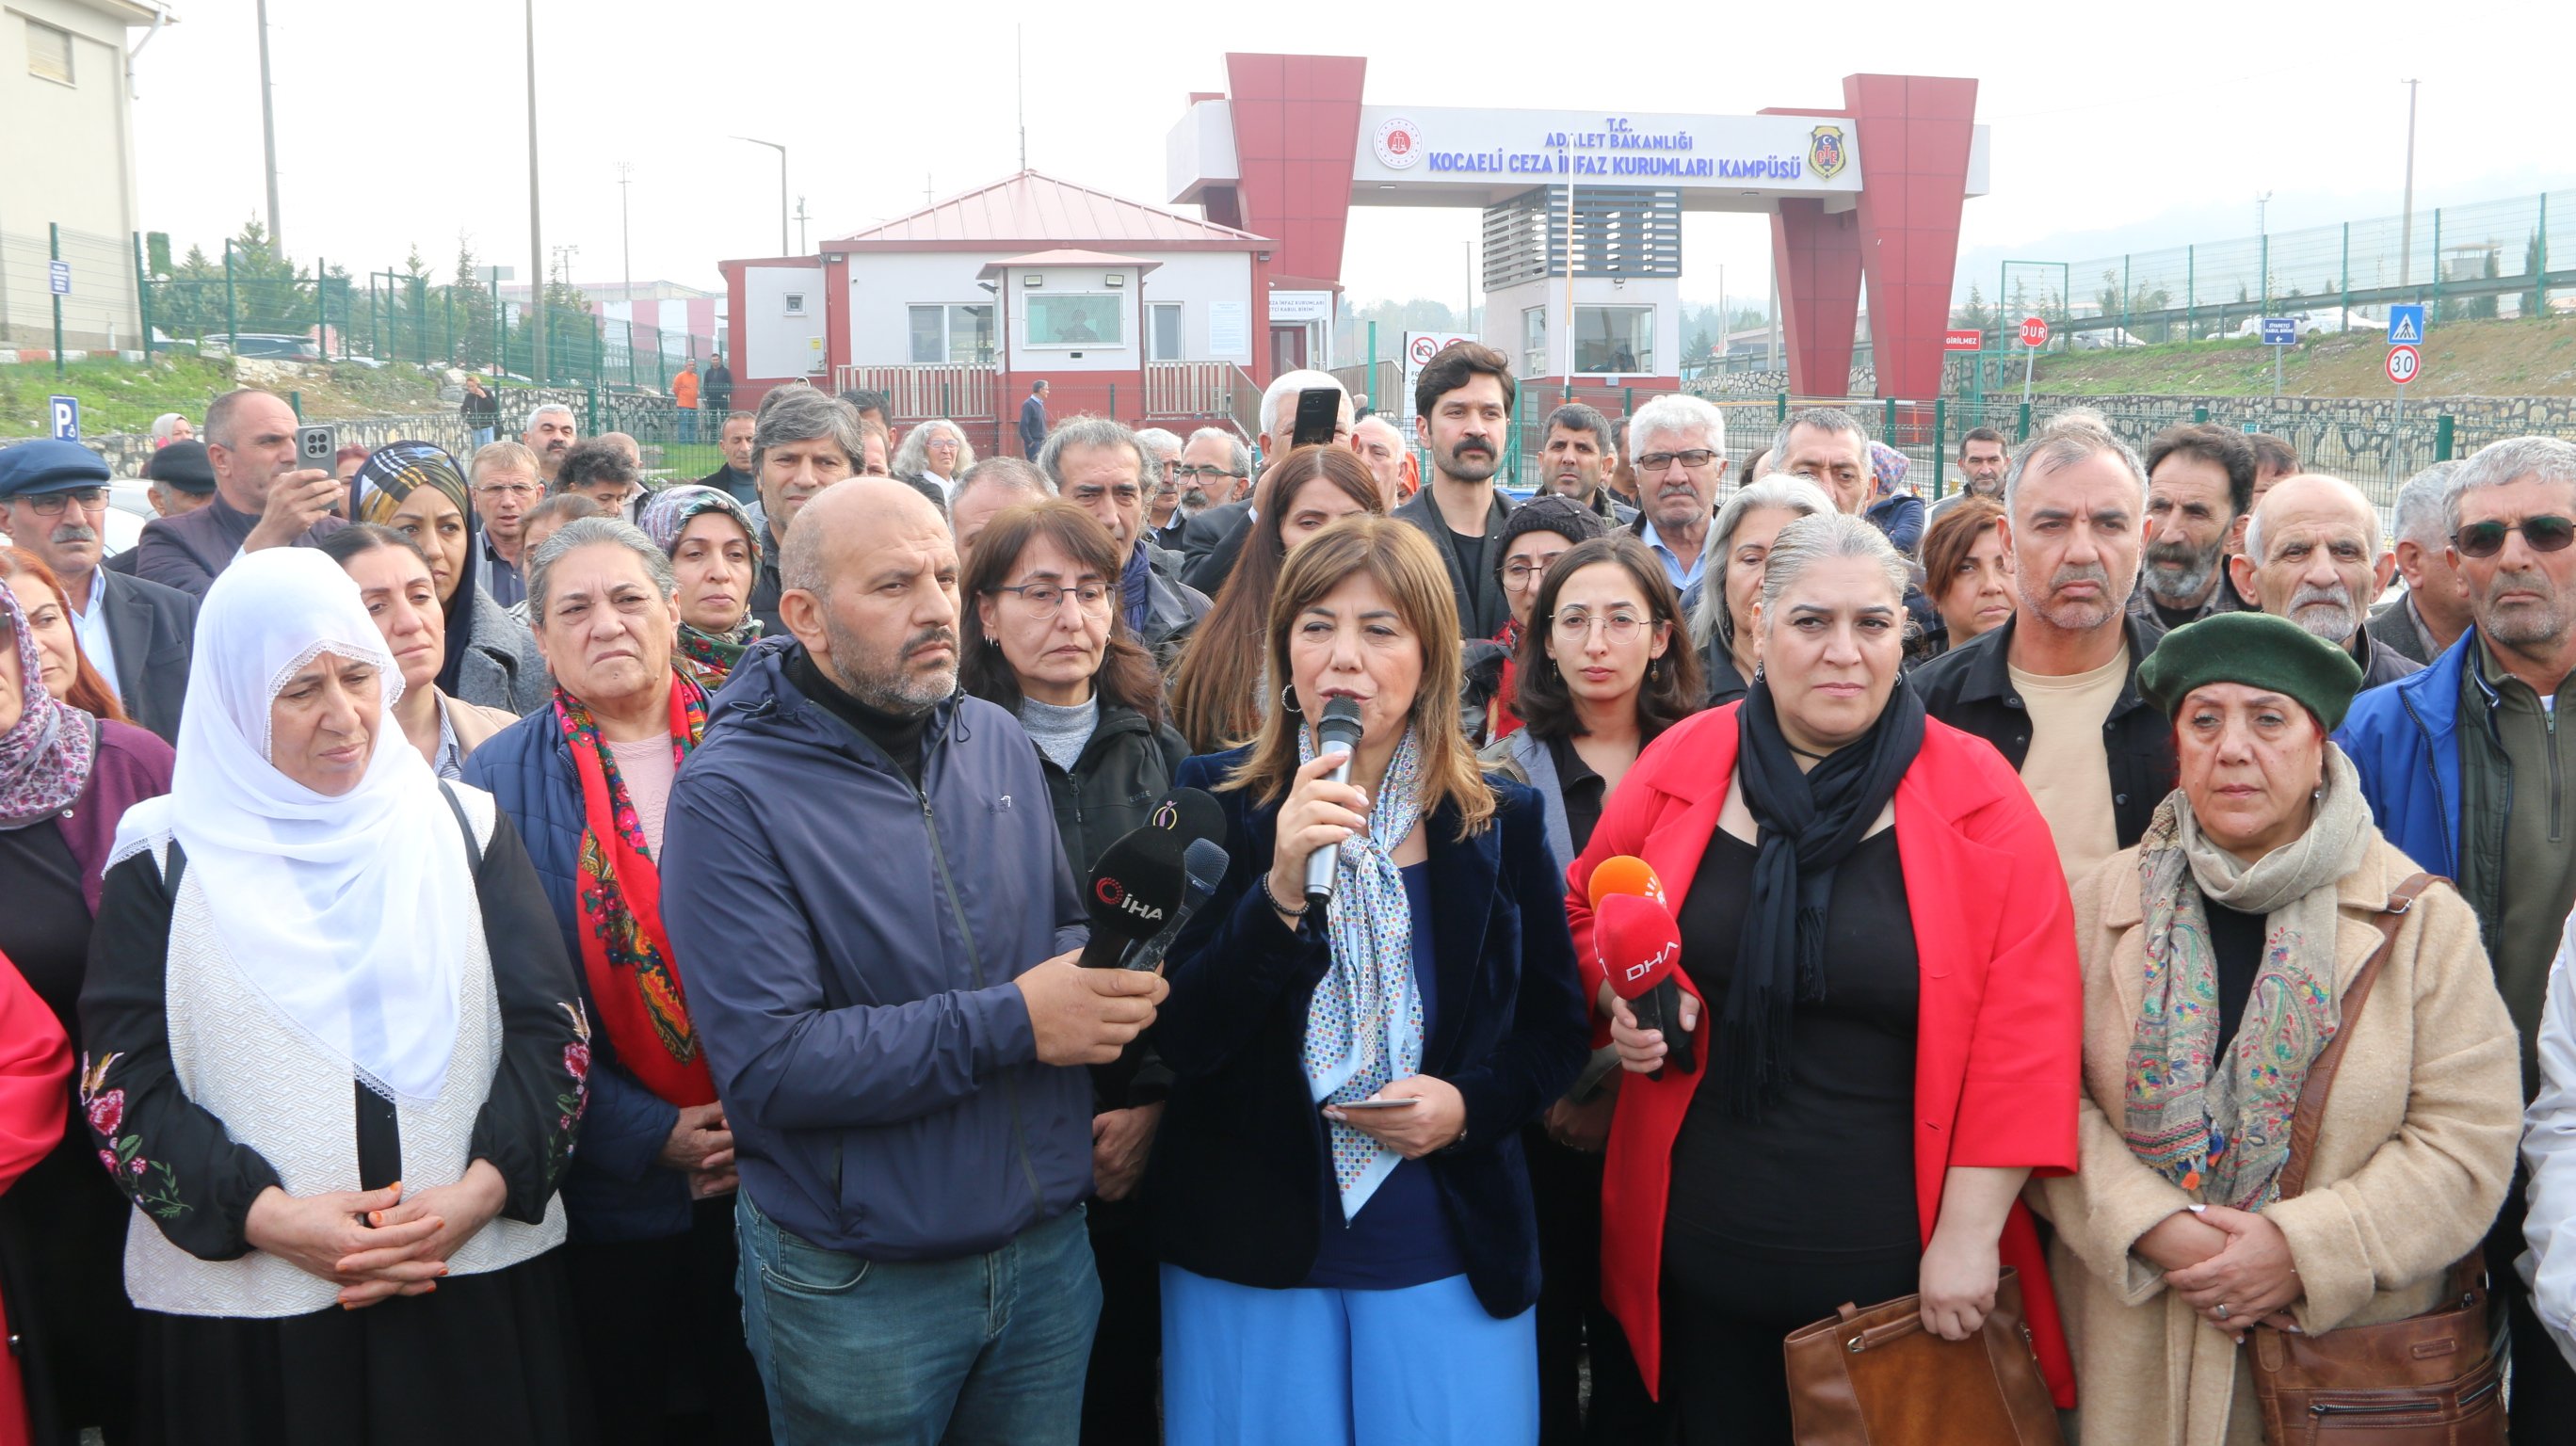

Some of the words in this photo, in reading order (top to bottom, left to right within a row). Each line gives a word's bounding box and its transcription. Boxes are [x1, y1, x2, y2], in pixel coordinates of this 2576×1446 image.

[1606, 118, 1634, 132] T.C.
[1610, 131, 1693, 151] BAKANLIĞI
[1429, 148, 1504, 172] KOCAELİ
[1508, 153, 1553, 173] CEZA
[1613, 156, 1713, 177] KURUMLARI
[1719, 155, 1801, 179] KAMPÜSÜ
[1946, 336, 1977, 345] GİRİLMEZ
[2021, 325, 2045, 339] DUR
[2392, 356, 2413, 373] 30
[55, 403, 72, 438] P
[1121, 893, 1163, 921] İHA
[1626, 941, 1679, 982] DHA
